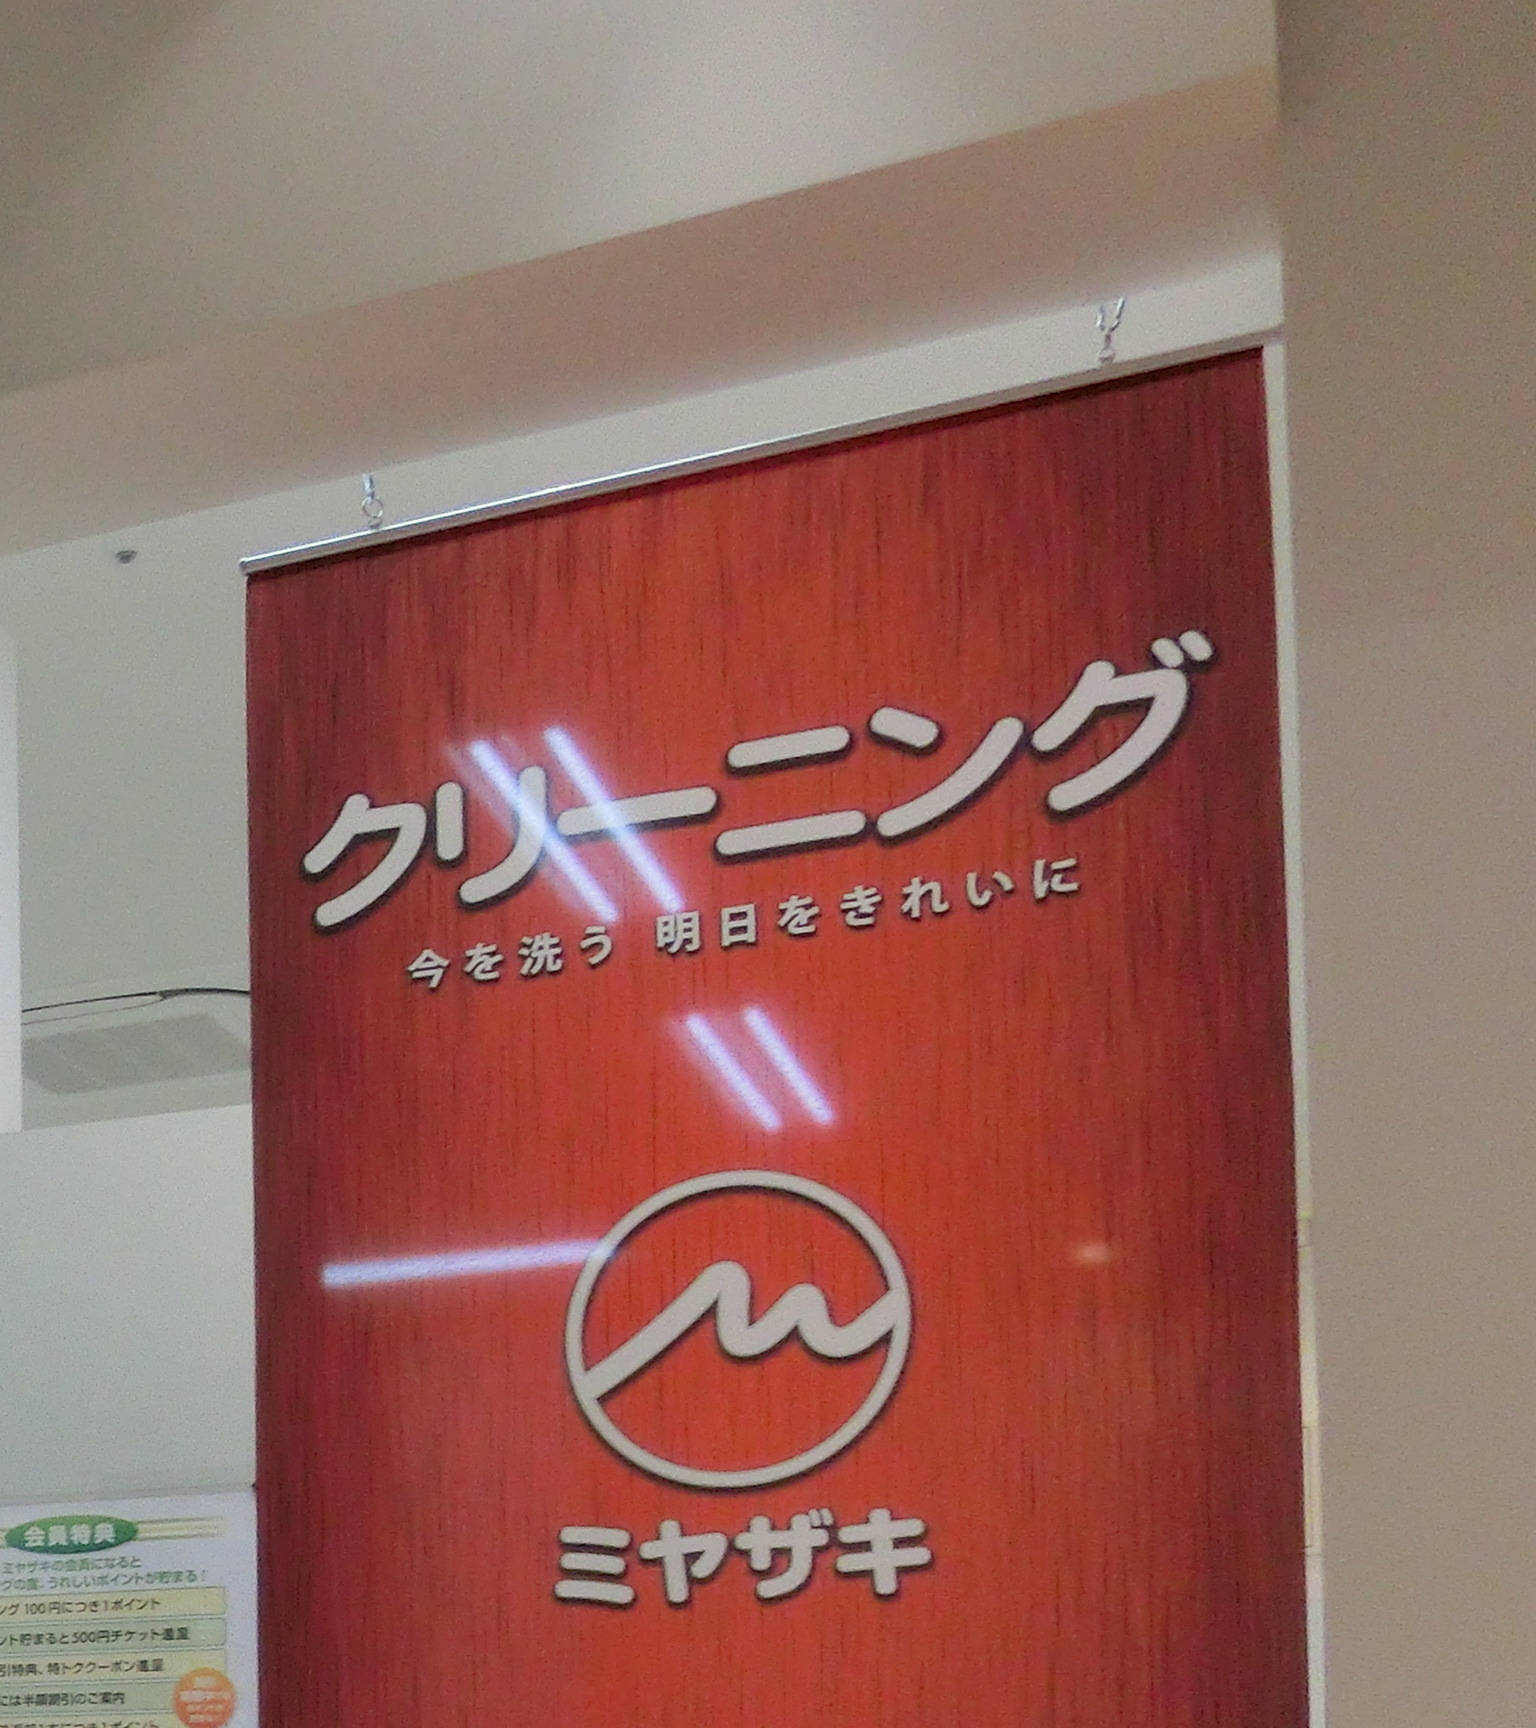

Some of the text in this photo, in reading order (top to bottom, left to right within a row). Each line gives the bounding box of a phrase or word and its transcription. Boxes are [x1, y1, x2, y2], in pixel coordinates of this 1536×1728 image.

[300, 628, 1214, 930] クリーニング
[406, 854, 1082, 990] 今を洗う 明日をきれいに
[553, 1506, 931, 1606] ミヤザキ
